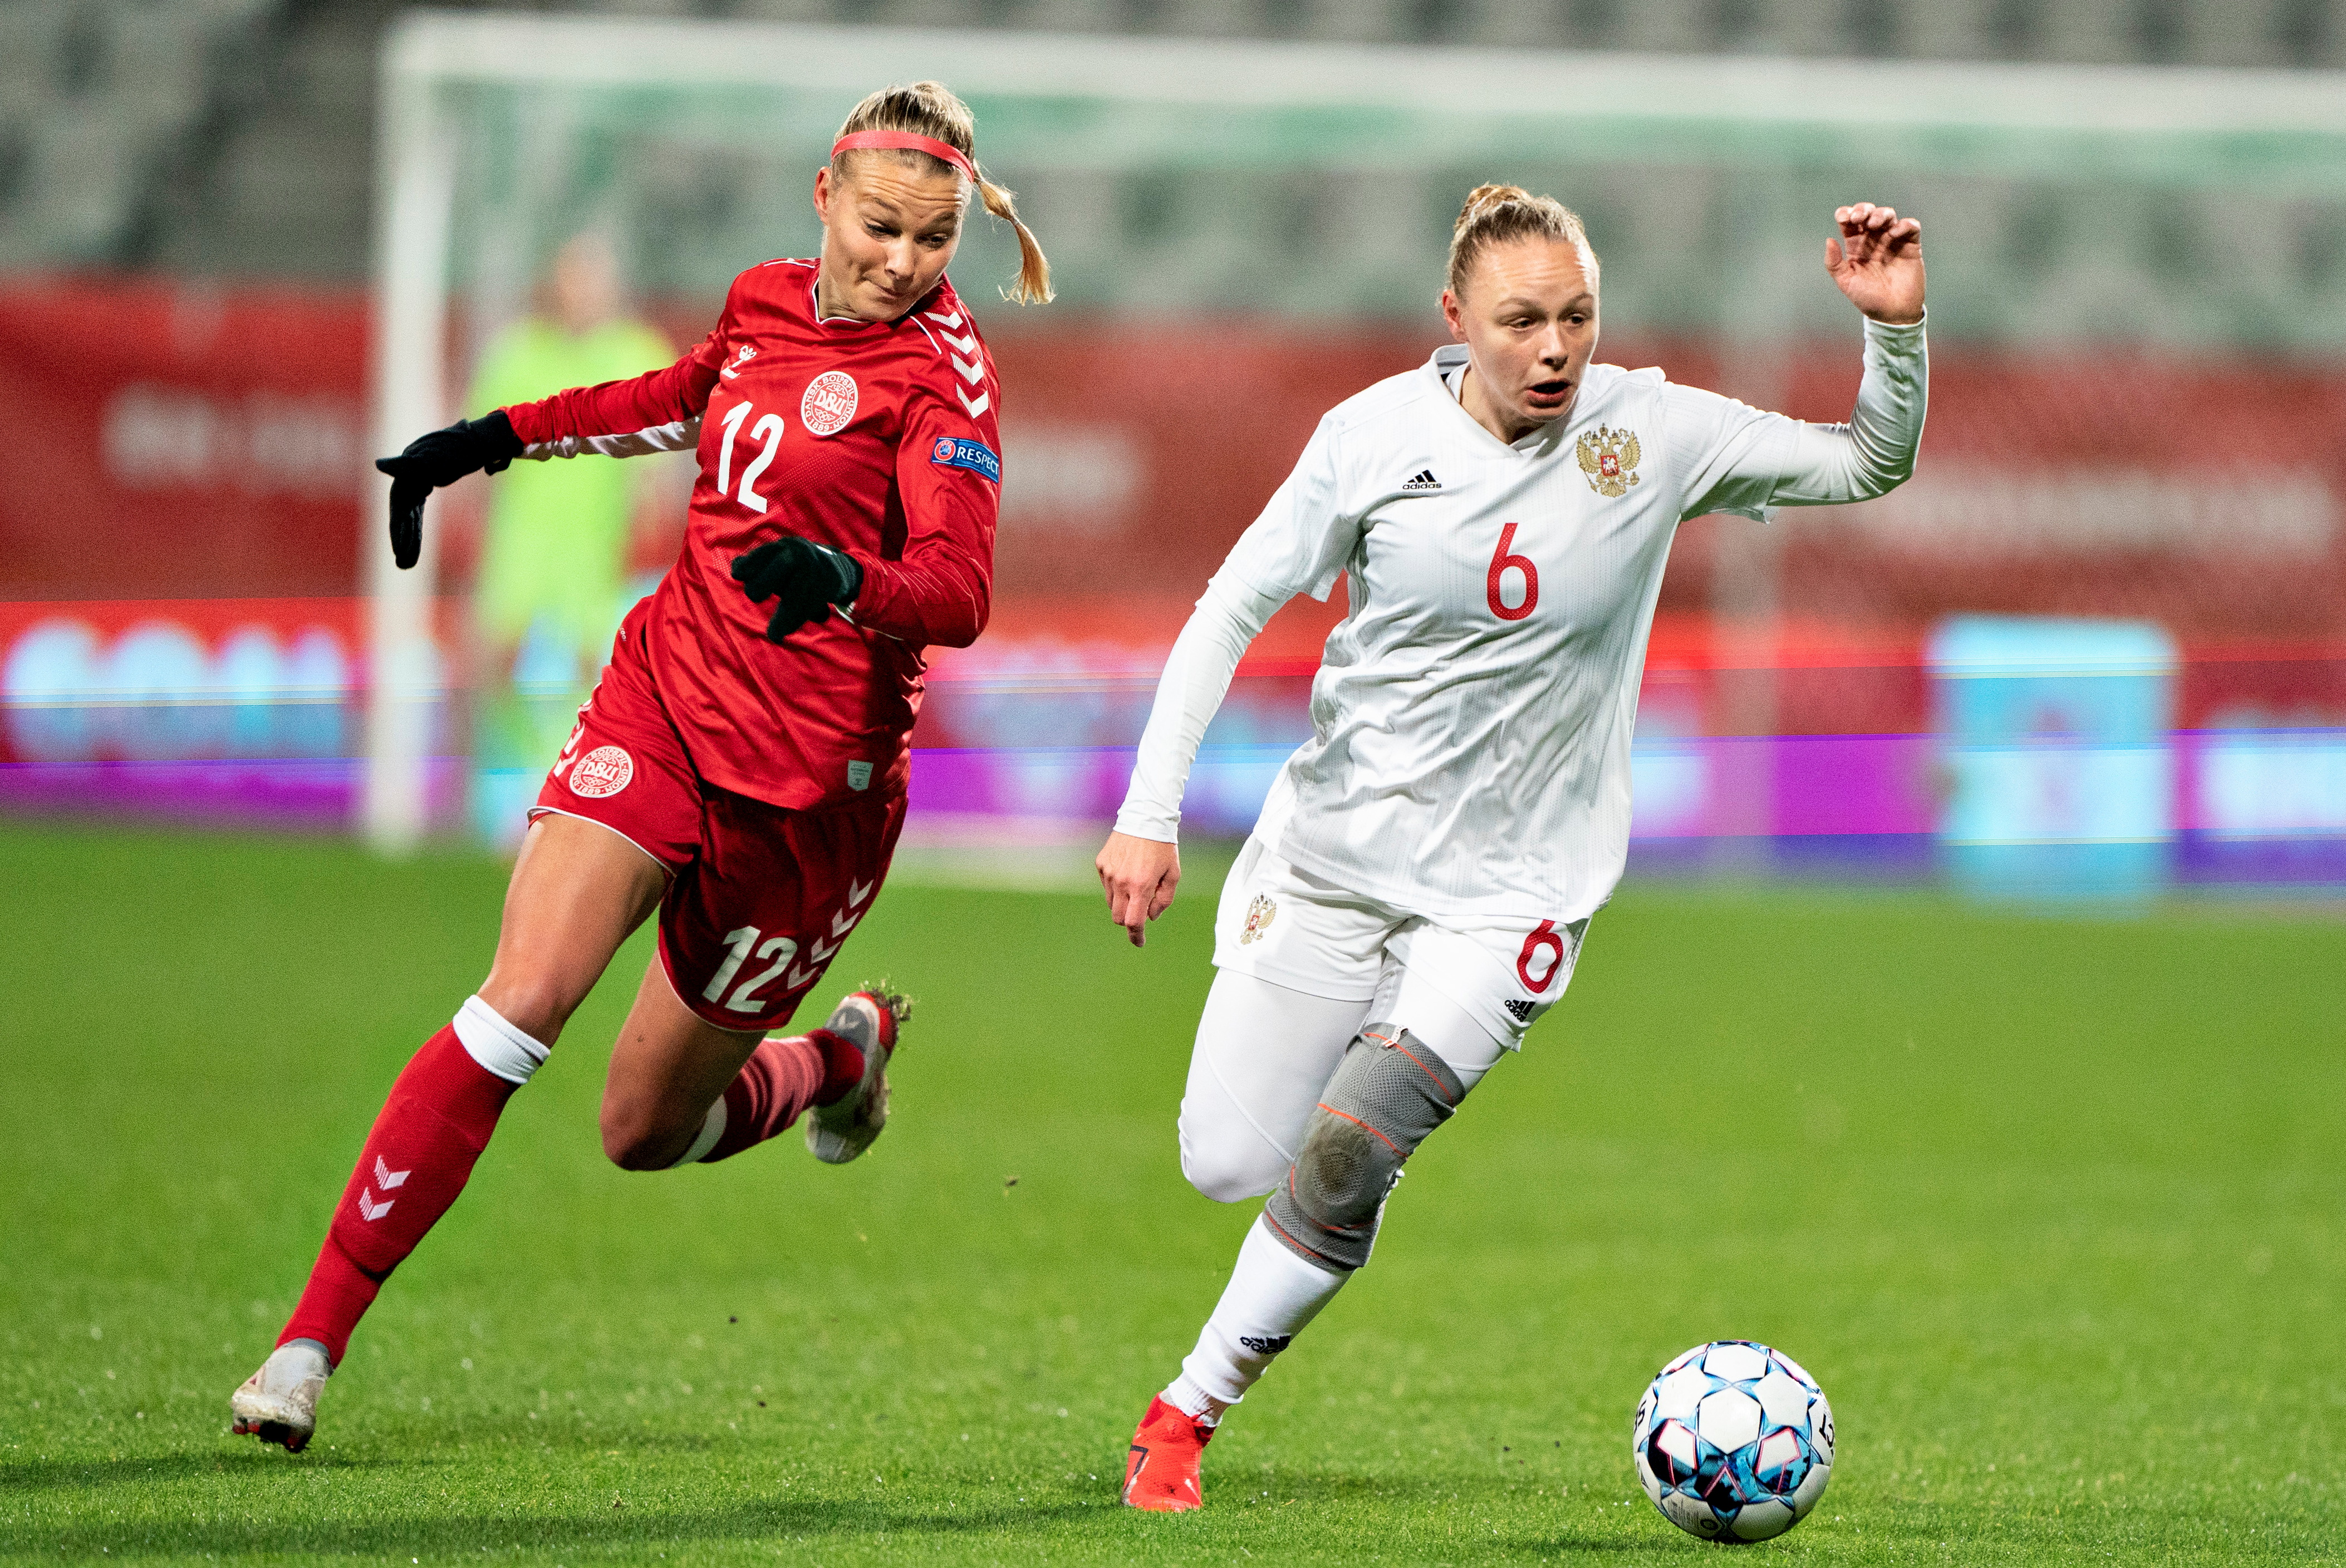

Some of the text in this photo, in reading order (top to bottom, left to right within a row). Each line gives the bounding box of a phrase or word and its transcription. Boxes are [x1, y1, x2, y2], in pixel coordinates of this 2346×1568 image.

[805, 381, 821, 417] DANSK
[813, 389, 847, 415] DBU
[808, 419, 830, 431] 1889
[833, 400, 855, 429] UNION
[718, 401, 784, 514] 12
[956, 446, 999, 475] RESPECT
[1487, 523, 1538, 620] 6
[582, 761, 619, 781] DBU
[604, 768, 629, 793] UNION
[577, 785, 601, 794] 1889
[702, 926, 798, 1013] 12
[1516, 919, 1564, 994] 6
